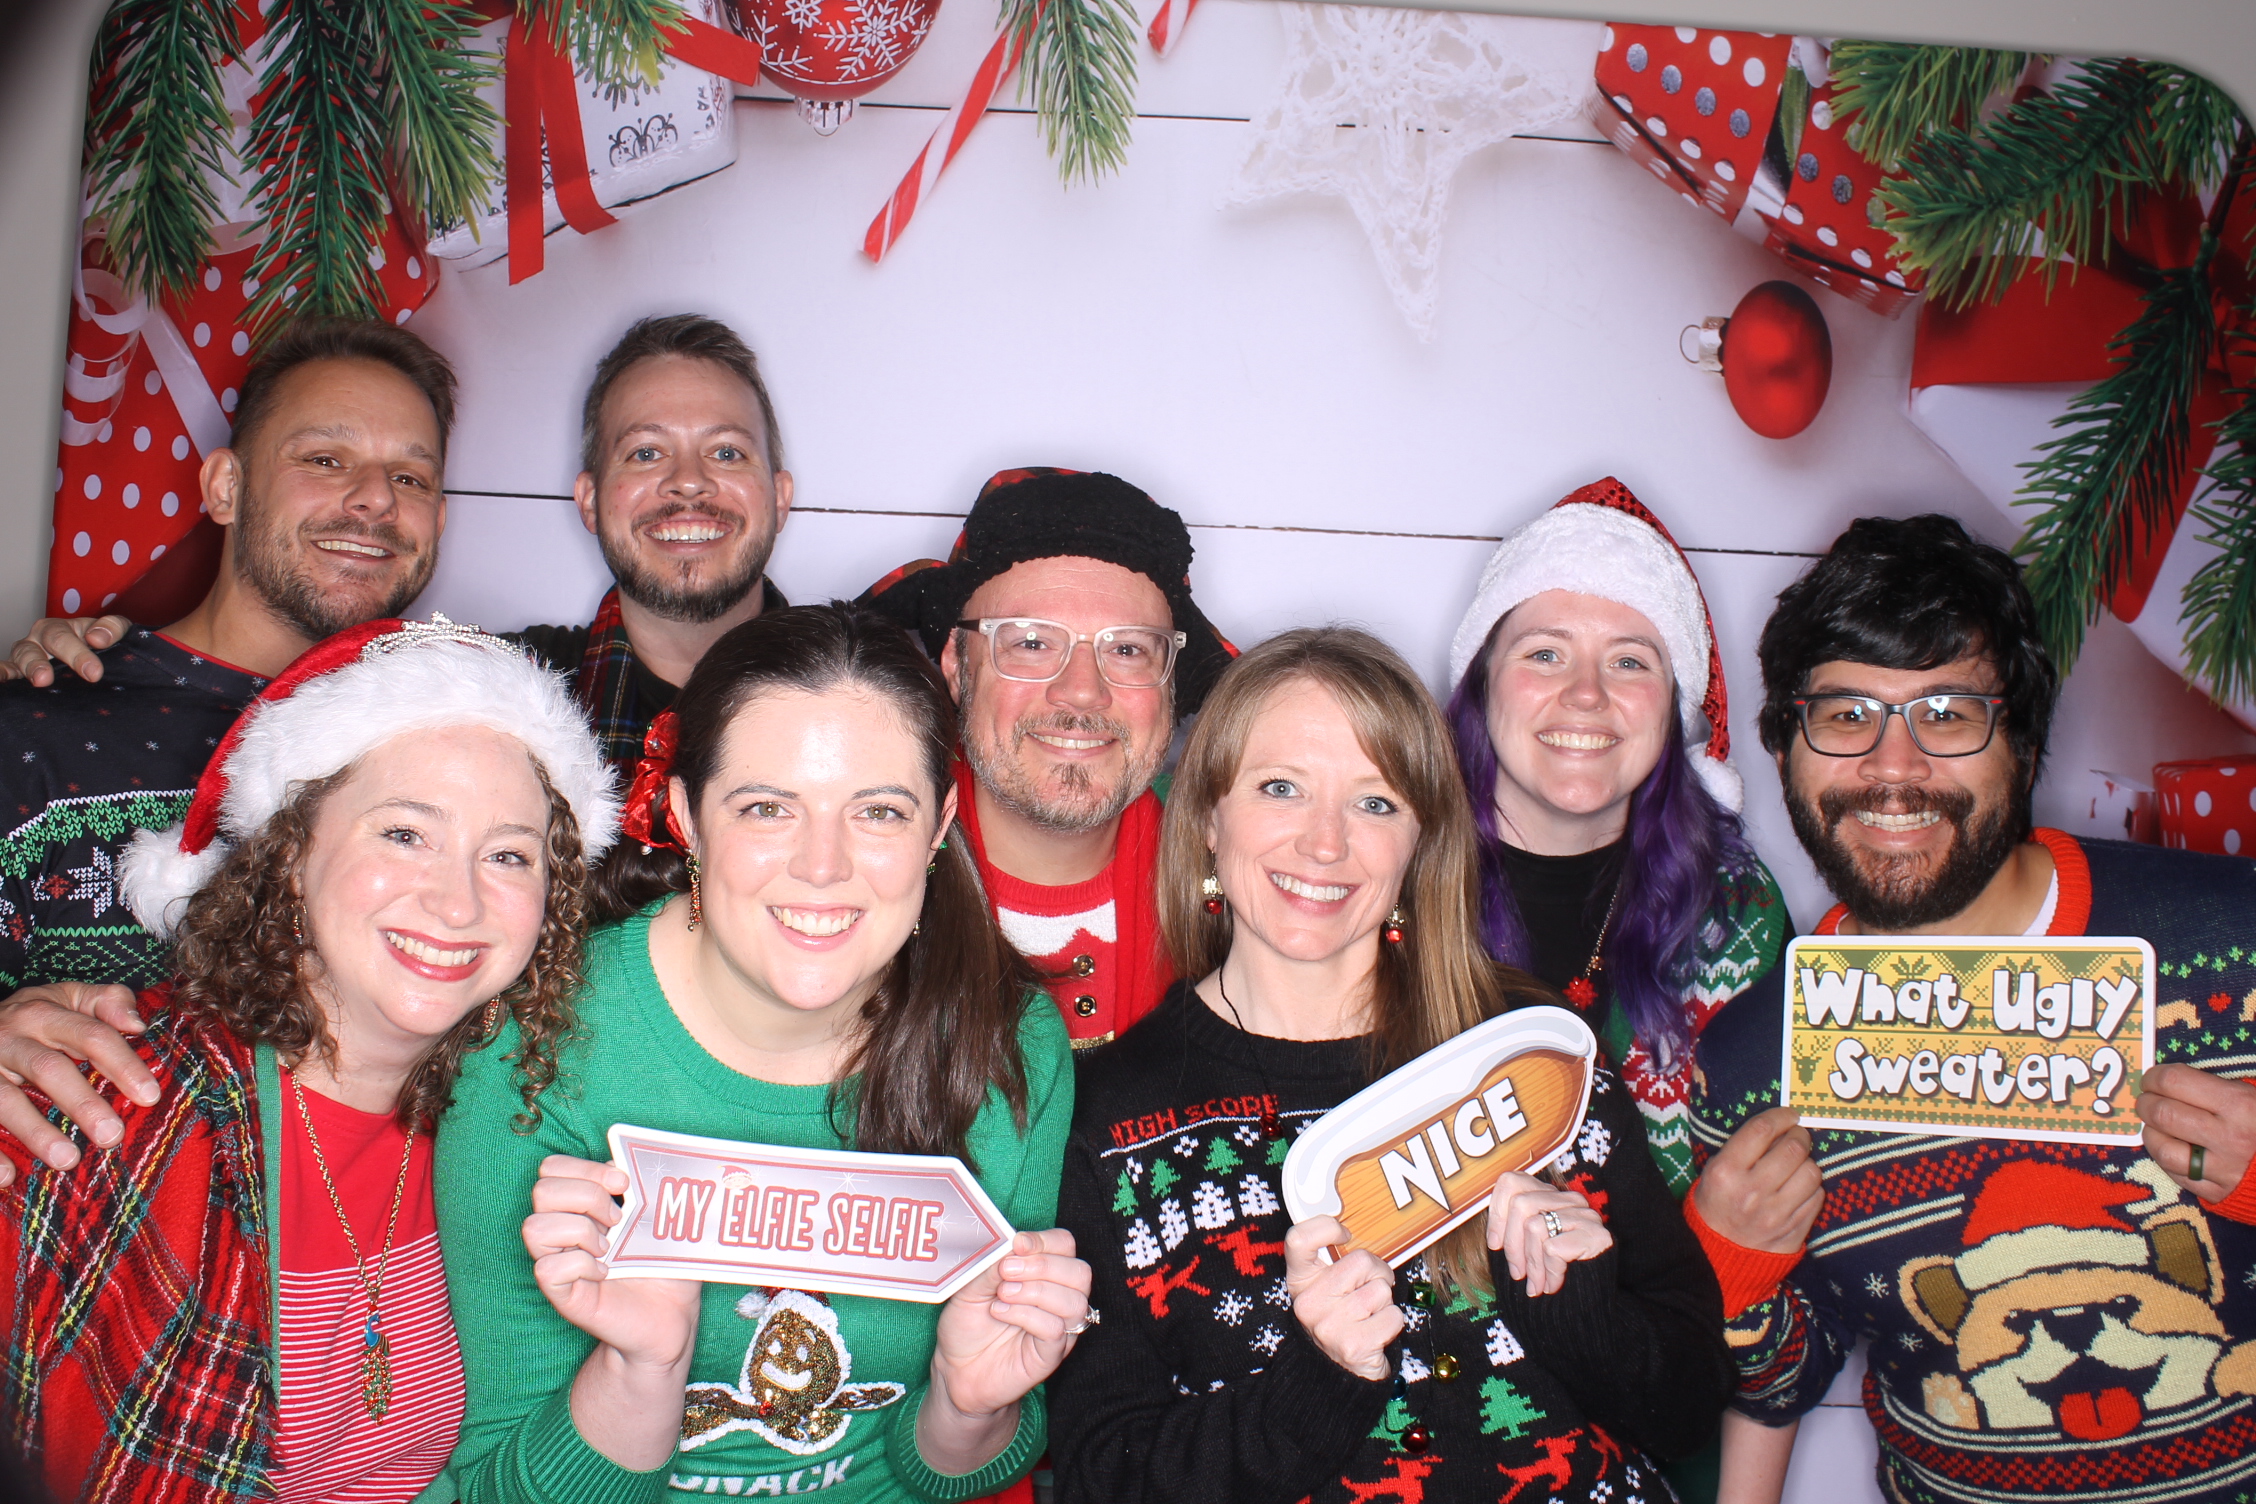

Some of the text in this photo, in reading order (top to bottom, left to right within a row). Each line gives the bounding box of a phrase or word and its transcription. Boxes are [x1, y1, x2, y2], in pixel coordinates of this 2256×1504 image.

[1800, 968, 2140, 1040] What Ugly
[1828, 1038, 2125, 1114] Sweater?
[1109, 1094, 1278, 1148] HIGH SCORE
[1378, 1076, 1529, 1214] NICE
[655, 1179, 942, 1260] MY ELFIE SELFIE
